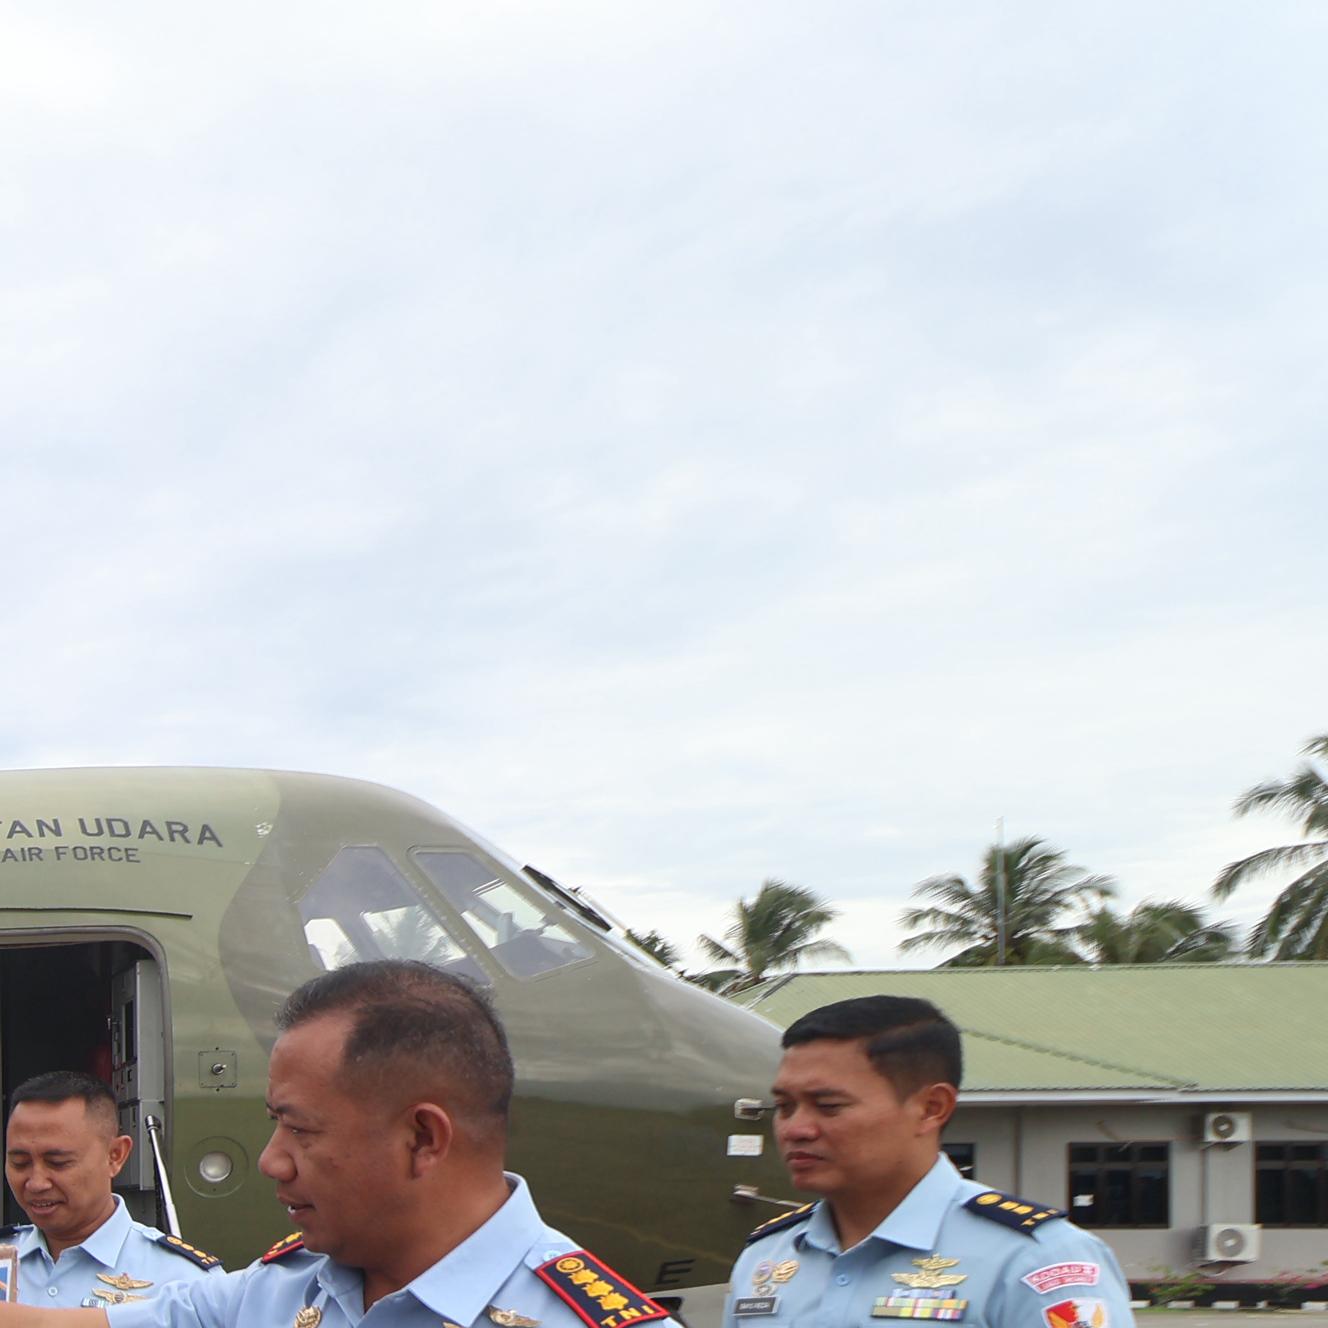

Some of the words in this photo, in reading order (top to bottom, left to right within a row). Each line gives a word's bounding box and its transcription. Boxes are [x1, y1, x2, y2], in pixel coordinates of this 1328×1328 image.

[77, 816, 224, 848] UDARA
[0, 846, 45, 864] AIR
[54, 844, 143, 864] FORCE
[600, 1304, 655, 1328] TNI
